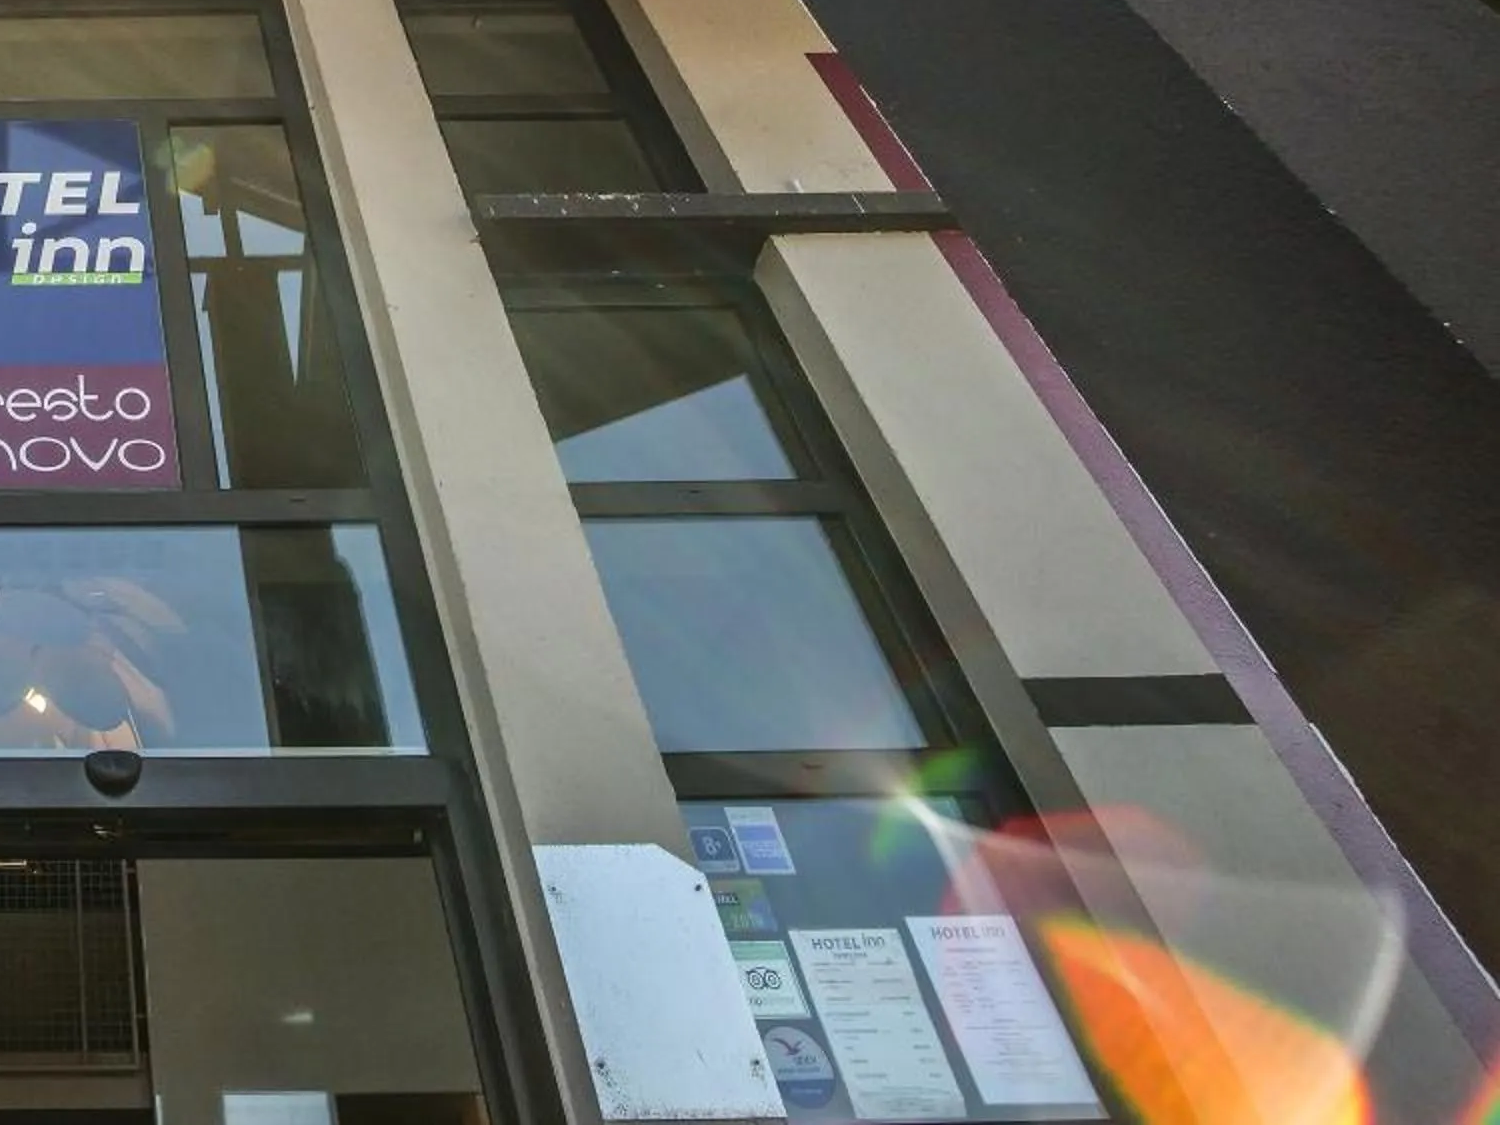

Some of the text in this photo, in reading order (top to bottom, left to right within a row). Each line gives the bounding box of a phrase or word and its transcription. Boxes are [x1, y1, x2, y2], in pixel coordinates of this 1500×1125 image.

[11, 222, 145, 273] inn
[810, 932, 885, 950] HOTEL inn
[930, 926, 979, 940] HOTEL
